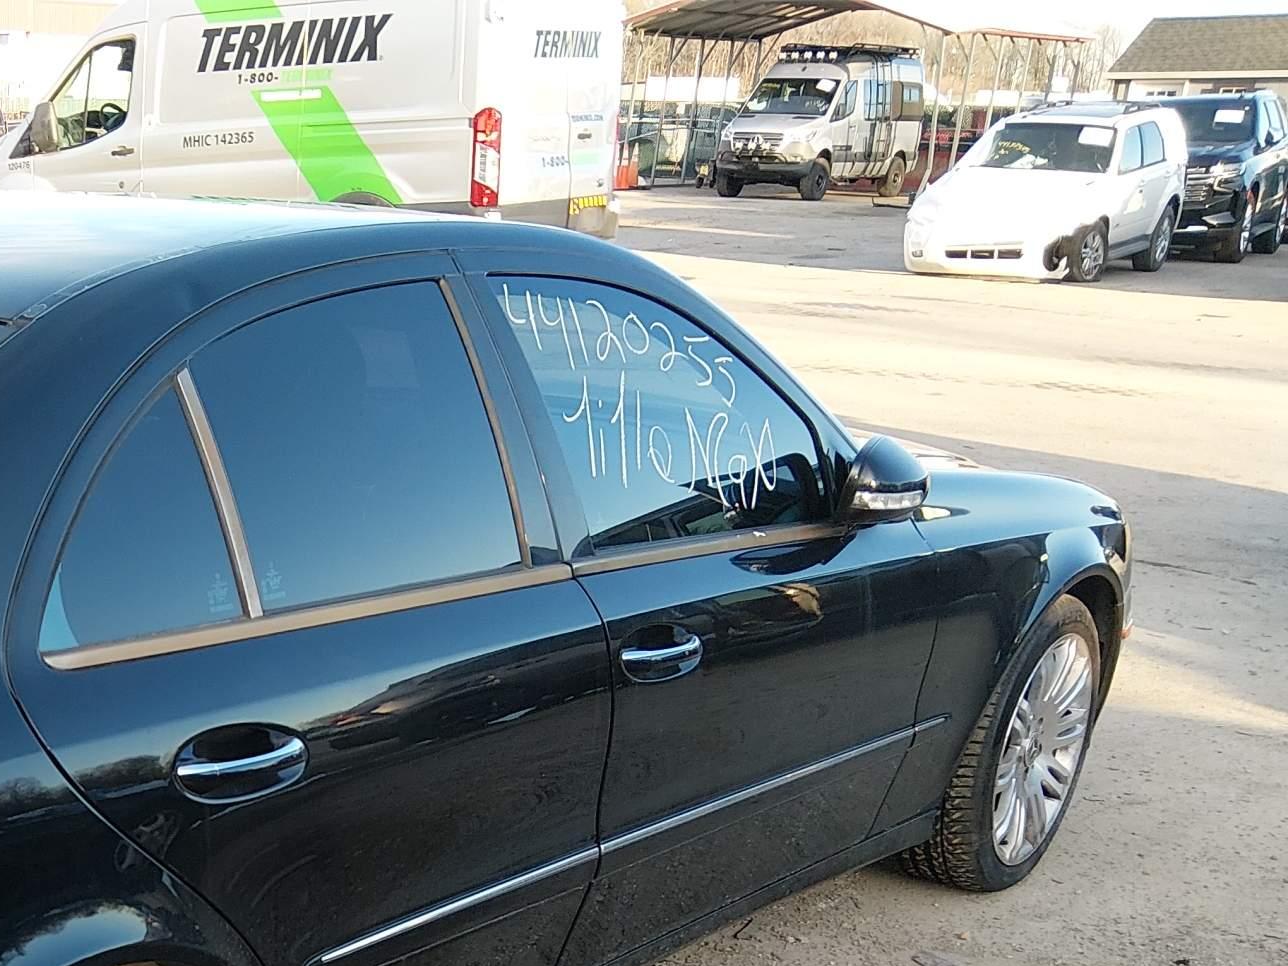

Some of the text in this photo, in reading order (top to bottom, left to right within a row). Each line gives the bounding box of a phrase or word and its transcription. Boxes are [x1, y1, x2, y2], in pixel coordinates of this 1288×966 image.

[196, 13, 393, 73] TERMINIX
[533, 30, 601, 58] TERMINIX
[183, 131, 255, 148] MHIC 142365
[503, 283, 736, 408] 44120255
